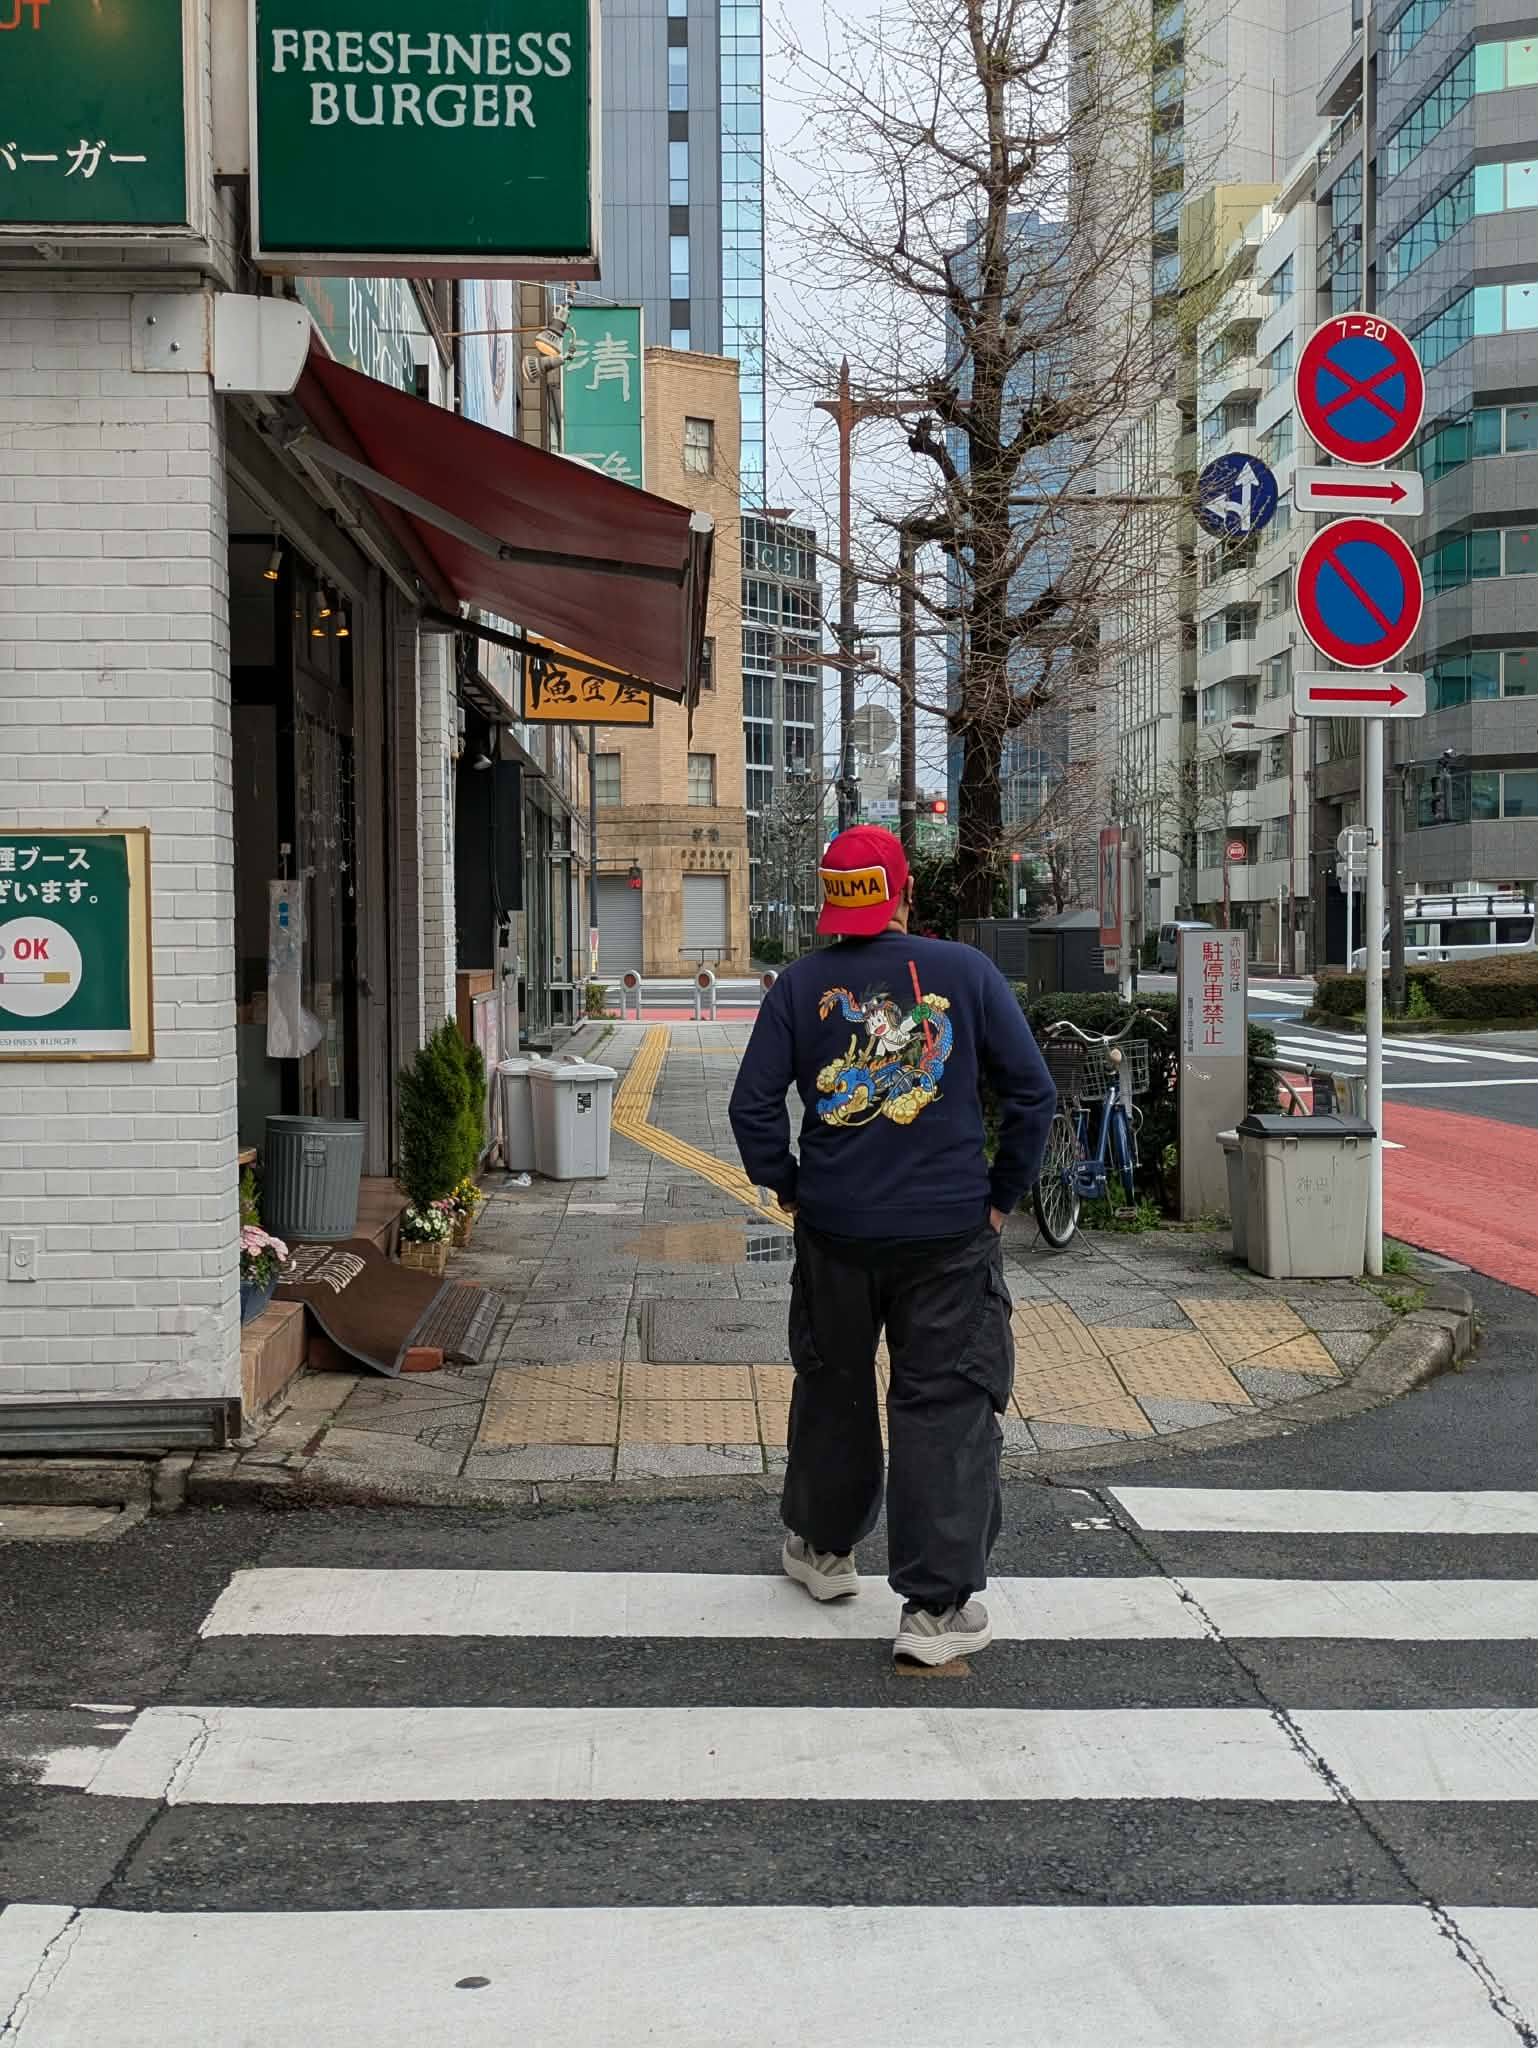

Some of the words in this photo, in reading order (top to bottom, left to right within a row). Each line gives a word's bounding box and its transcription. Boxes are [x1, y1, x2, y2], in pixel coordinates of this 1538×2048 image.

[271, 28, 572, 77] FRESHNESS
[309, 82, 537, 129] BURGER
[1336, 319, 1388, 342] 7-20
[823, 877, 882, 897] BULMA
[13, 937, 49, 961] OK
[1202, 941, 1225, 1045] 駐停車禁止
